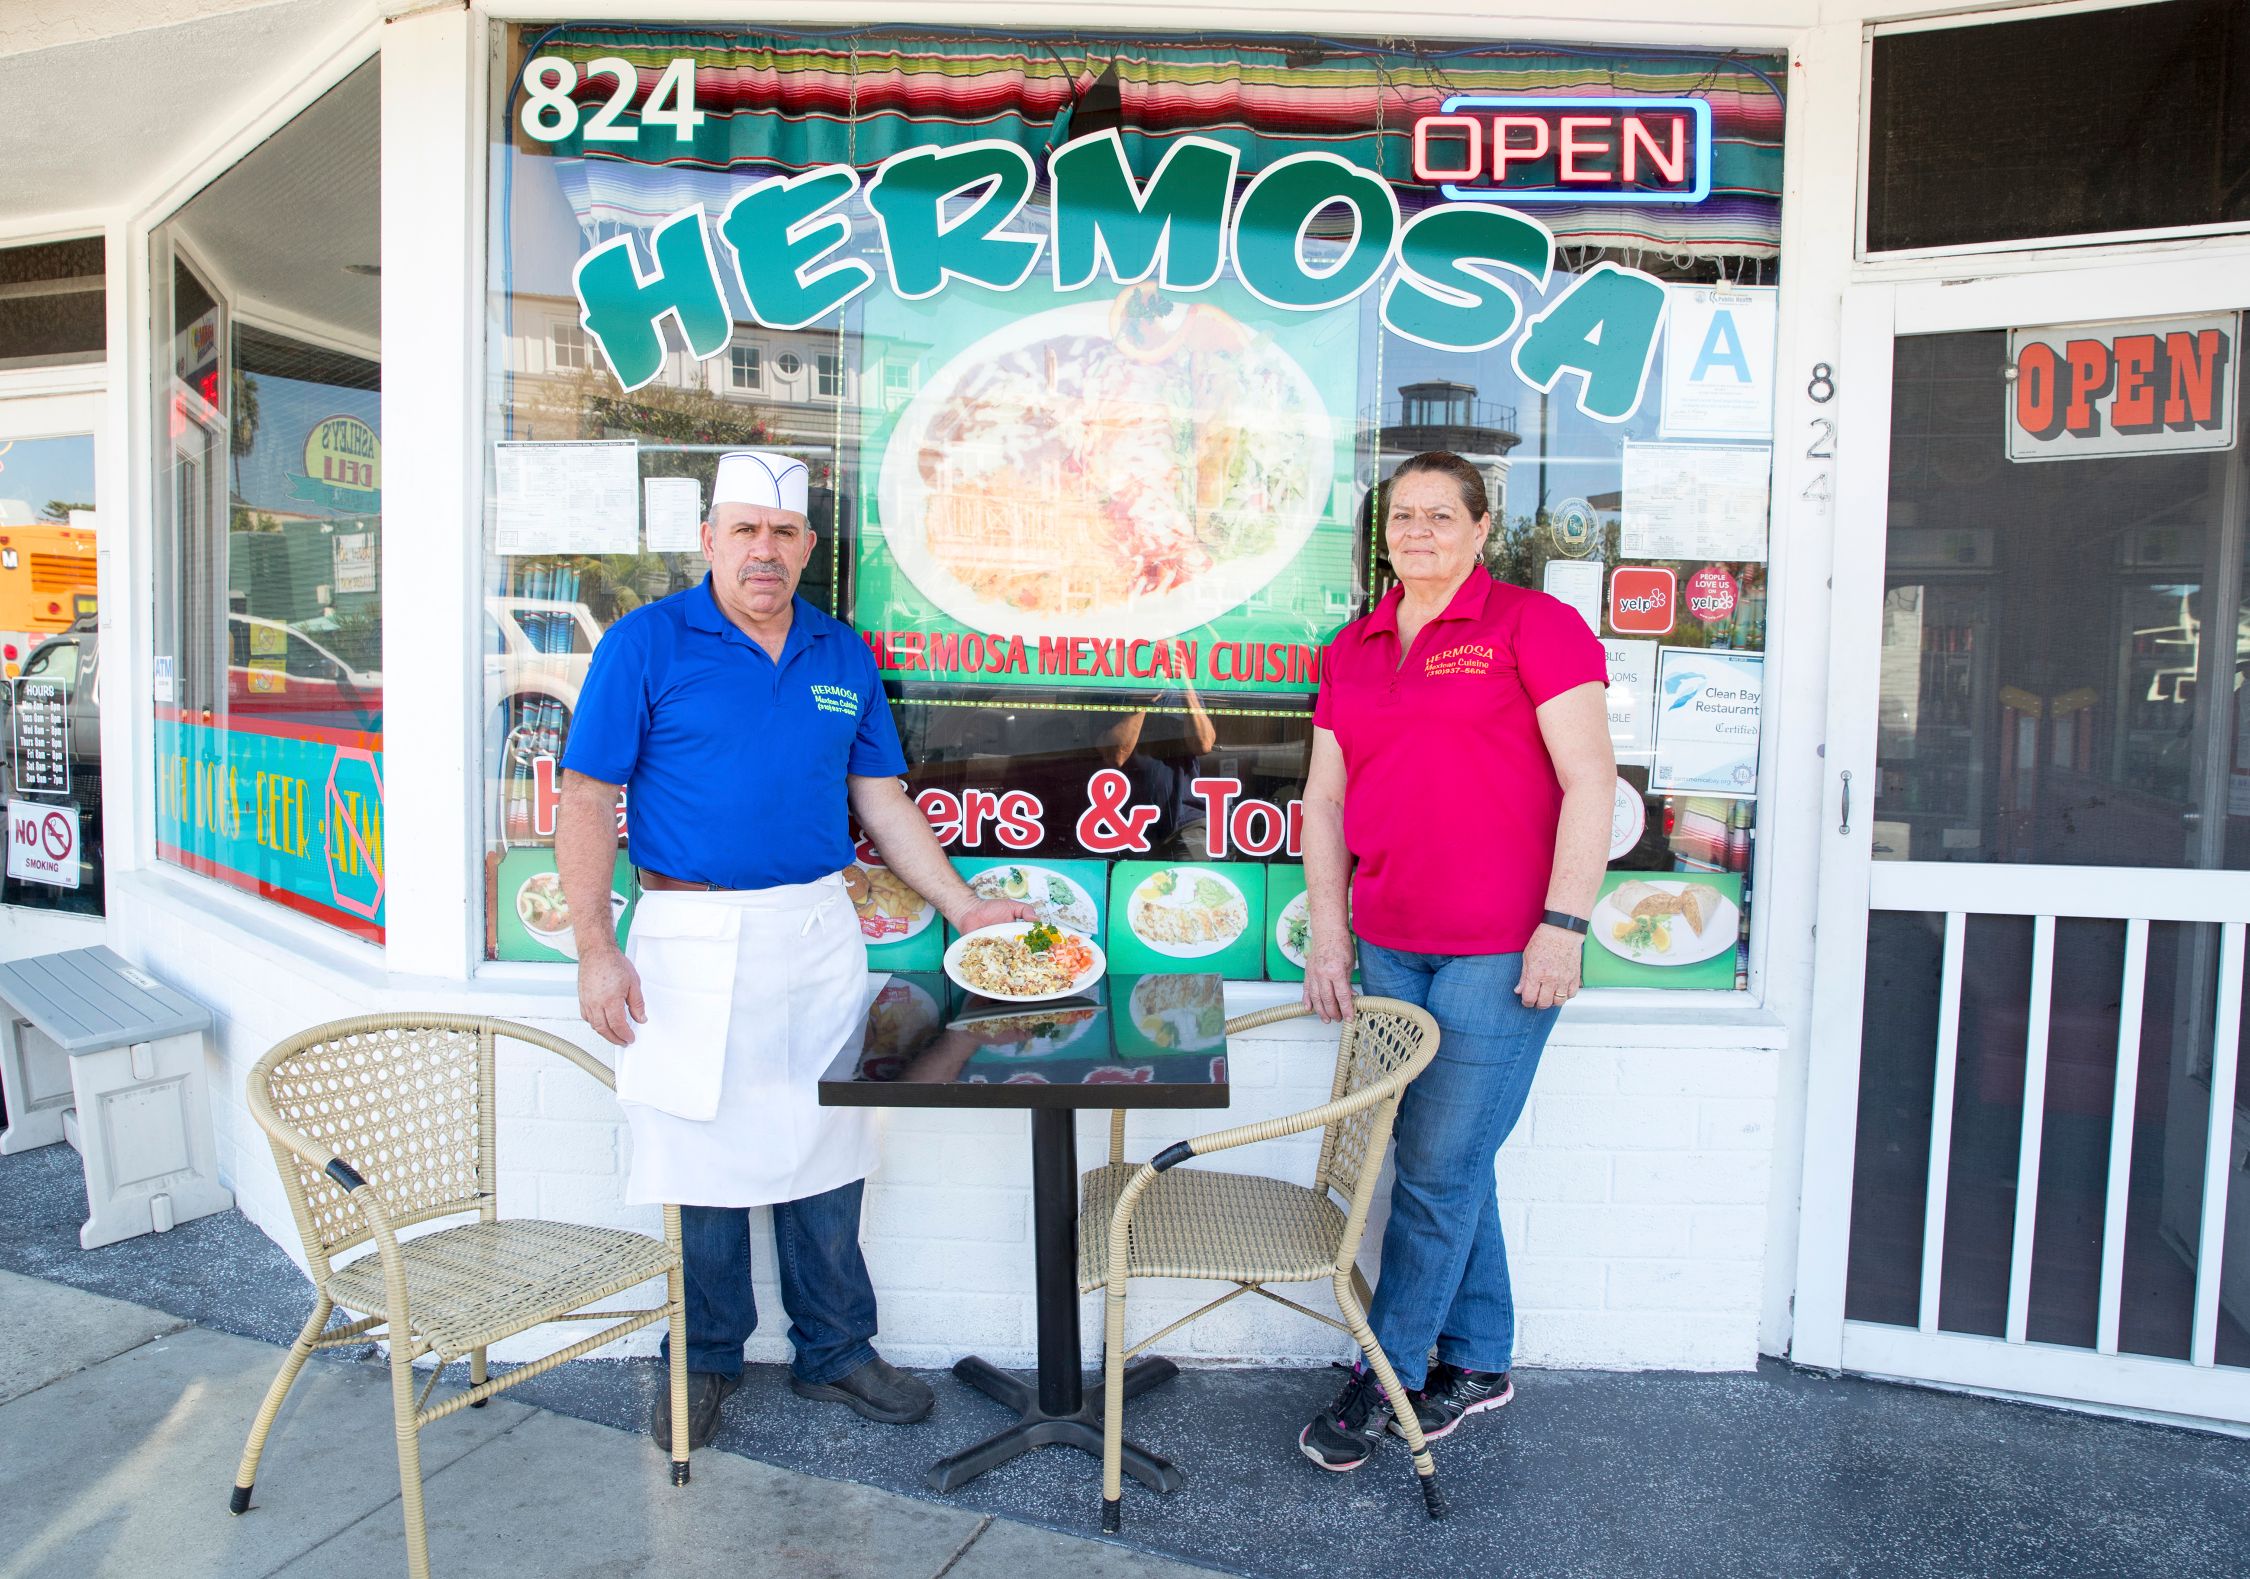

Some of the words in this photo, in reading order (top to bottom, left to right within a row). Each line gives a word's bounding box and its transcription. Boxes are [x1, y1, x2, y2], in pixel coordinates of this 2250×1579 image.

[520, 56, 705, 143] 824
[1414, 114, 1685, 184] OPEN
[571, 127, 1670, 424] HERMOSA
[1689, 310, 1753, 383] A
[2016, 328, 2226, 440] OPEN
[1695, 580, 1717, 588] LOVE
[1718, 581, 1730, 589] US
[1700, 573, 1726, 581] PEOPLE
[1620, 596, 1651, 613] yelp
[1691, 595, 1720, 612] yelp
[862, 630, 1029, 675] HERMOSA
[1038, 636, 1198, 680] MEXICAN
[1208, 641, 1328, 684] CUISIN
[1425, 644, 1494, 665] HERMOSA
[1605, 652, 1626, 662] BLIC
[155, 658, 173, 678] ATM
[1424, 661, 1457, 672] Mexican
[1457, 658, 1489, 669] Cuisine
[26, 685, 55, 697] HOURS
[810, 684, 859, 704] HERMOSA
[1705, 687, 1737, 700] Clean
[1739, 689, 1761, 703] Bay
[1695, 700, 1760, 716] Restaurant
[22, 712, 33, 723] Tues
[23, 725, 33, 735] Wed
[1715, 722, 1758, 735] Certified
[21, 736, 34, 747] Thurs
[27, 760, 35, 771] Sat
[27, 772, 35, 783] Sun
[160, 752, 188, 823] HOT
[194, 759, 241, 841] DOGS
[256, 770, 311, 861] BEER
[329, 789, 384, 880] ATM
[1076, 768, 1160, 853] &
[16, 819, 37, 846] NO
[26, 858, 59, 872] SMOKING
